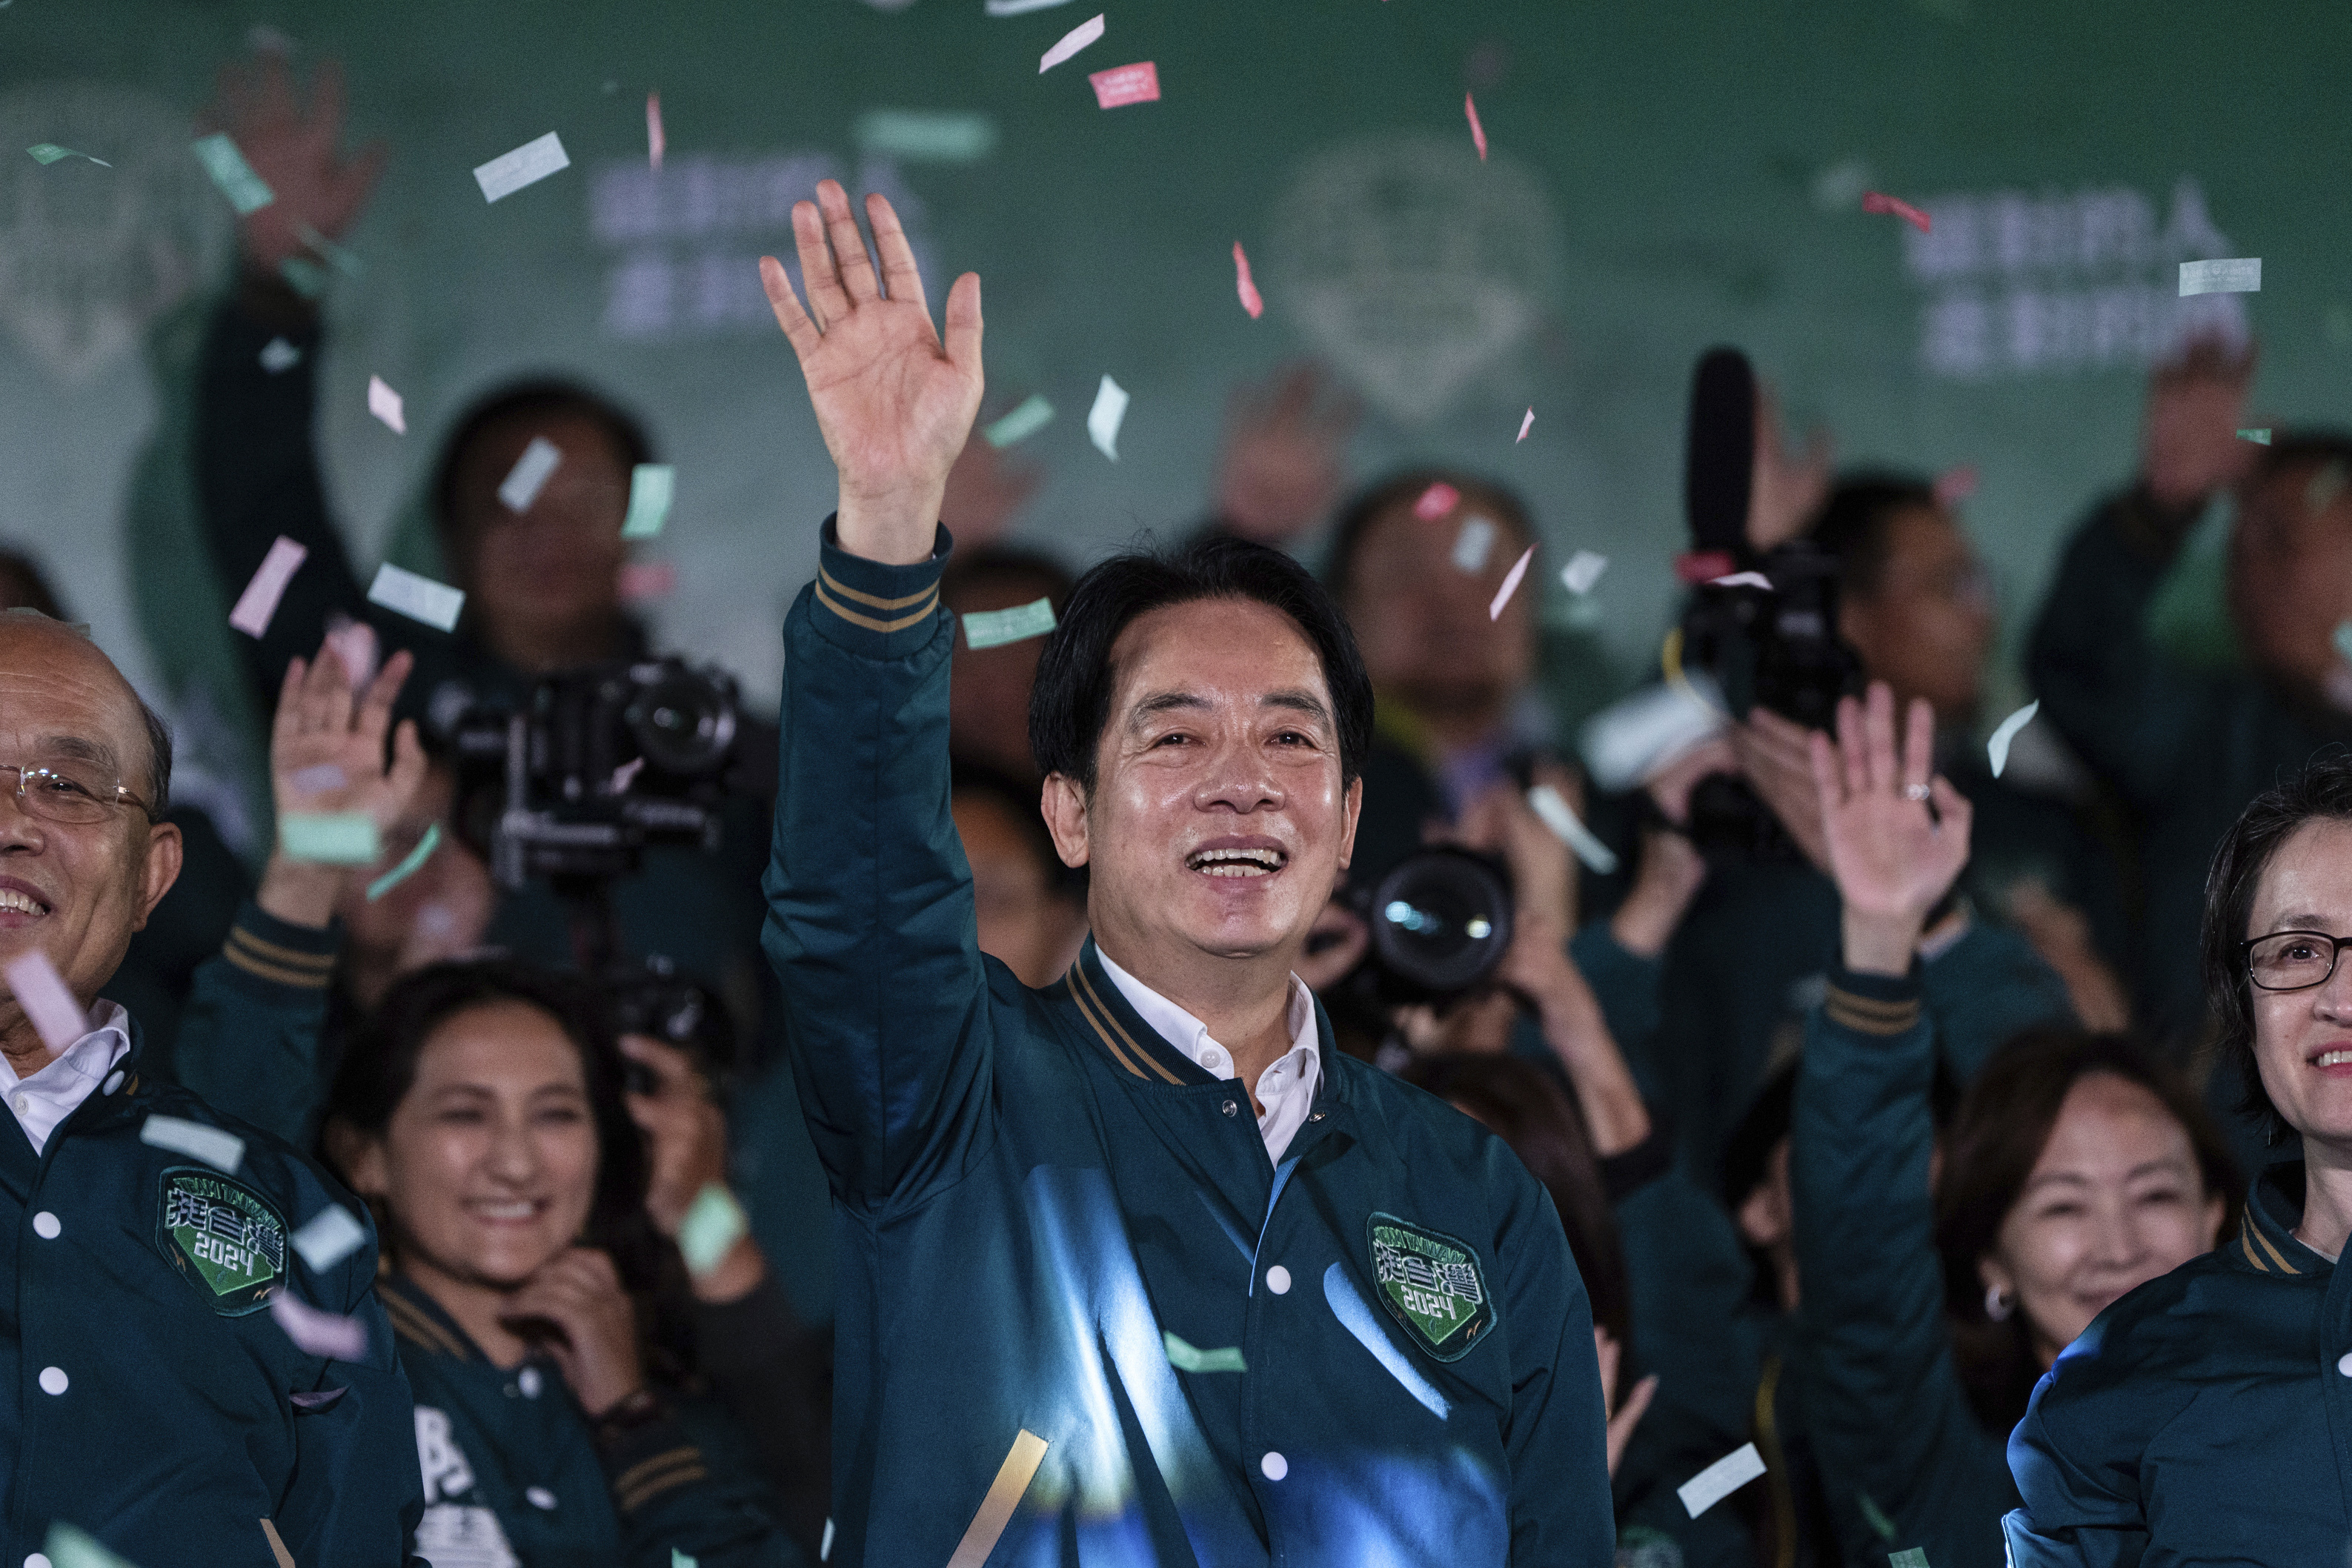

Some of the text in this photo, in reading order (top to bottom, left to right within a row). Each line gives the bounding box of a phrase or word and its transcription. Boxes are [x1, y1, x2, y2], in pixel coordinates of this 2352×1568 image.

[173, 1177, 221, 1199] TEAM
[194, 1232, 254, 1276] 2024
[1401, 1285, 1456, 1320] 2024
